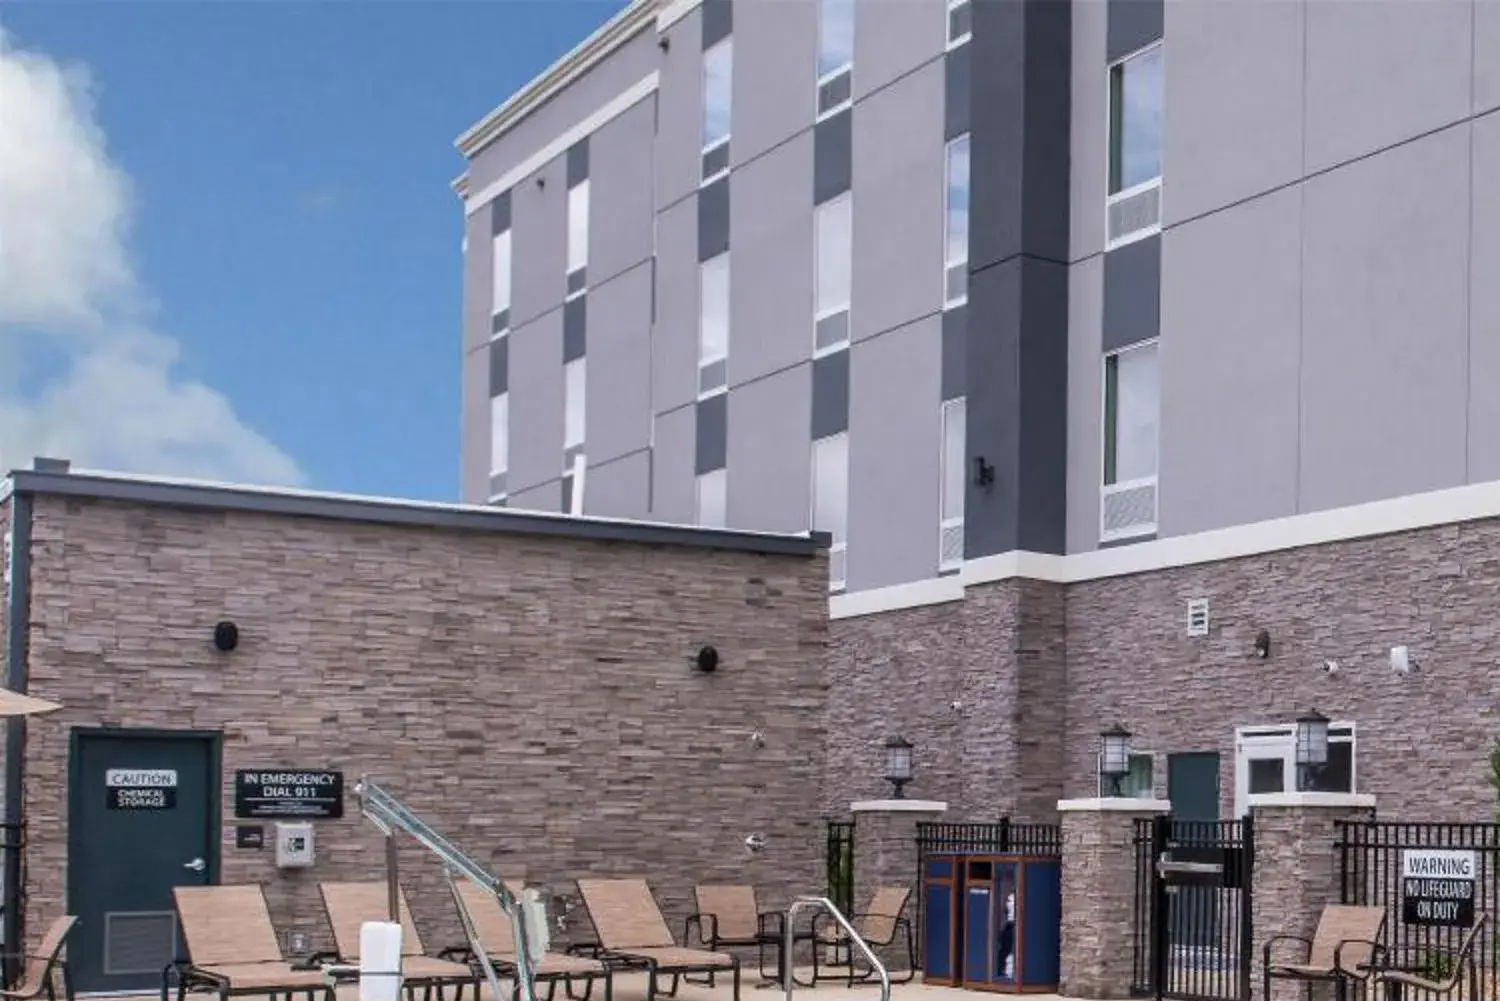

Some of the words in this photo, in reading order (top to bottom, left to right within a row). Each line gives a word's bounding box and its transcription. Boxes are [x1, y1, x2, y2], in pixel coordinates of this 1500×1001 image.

[111, 773, 172, 785] CAUTION
[244, 773, 259, 785] IN
[260, 773, 336, 785] EMERGENCY
[263, 786, 293, 797] DIAL
[294, 786, 317, 797] 911
[1408, 856, 1471, 876] WARNING
[1405, 879, 1421, 897] NO
[1421, 879, 1473, 899] LIFEGUARD
[1416, 900, 1432, 918] ON
[1433, 900, 1460, 920] DUTY
